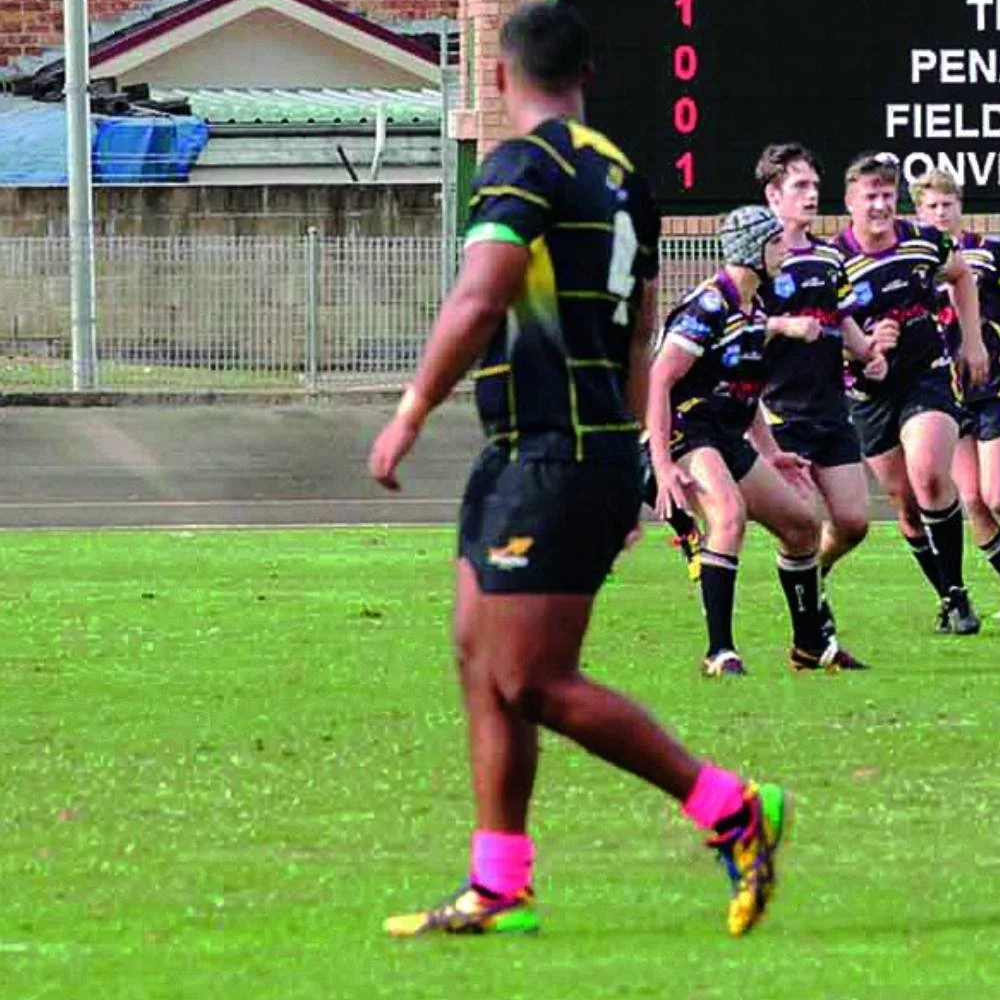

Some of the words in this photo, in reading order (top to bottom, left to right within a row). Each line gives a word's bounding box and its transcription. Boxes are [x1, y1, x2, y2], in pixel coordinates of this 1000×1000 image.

[674, 45, 698, 81] 0
[674, 96, 698, 134] 0
[675, 151, 694, 189] 1
